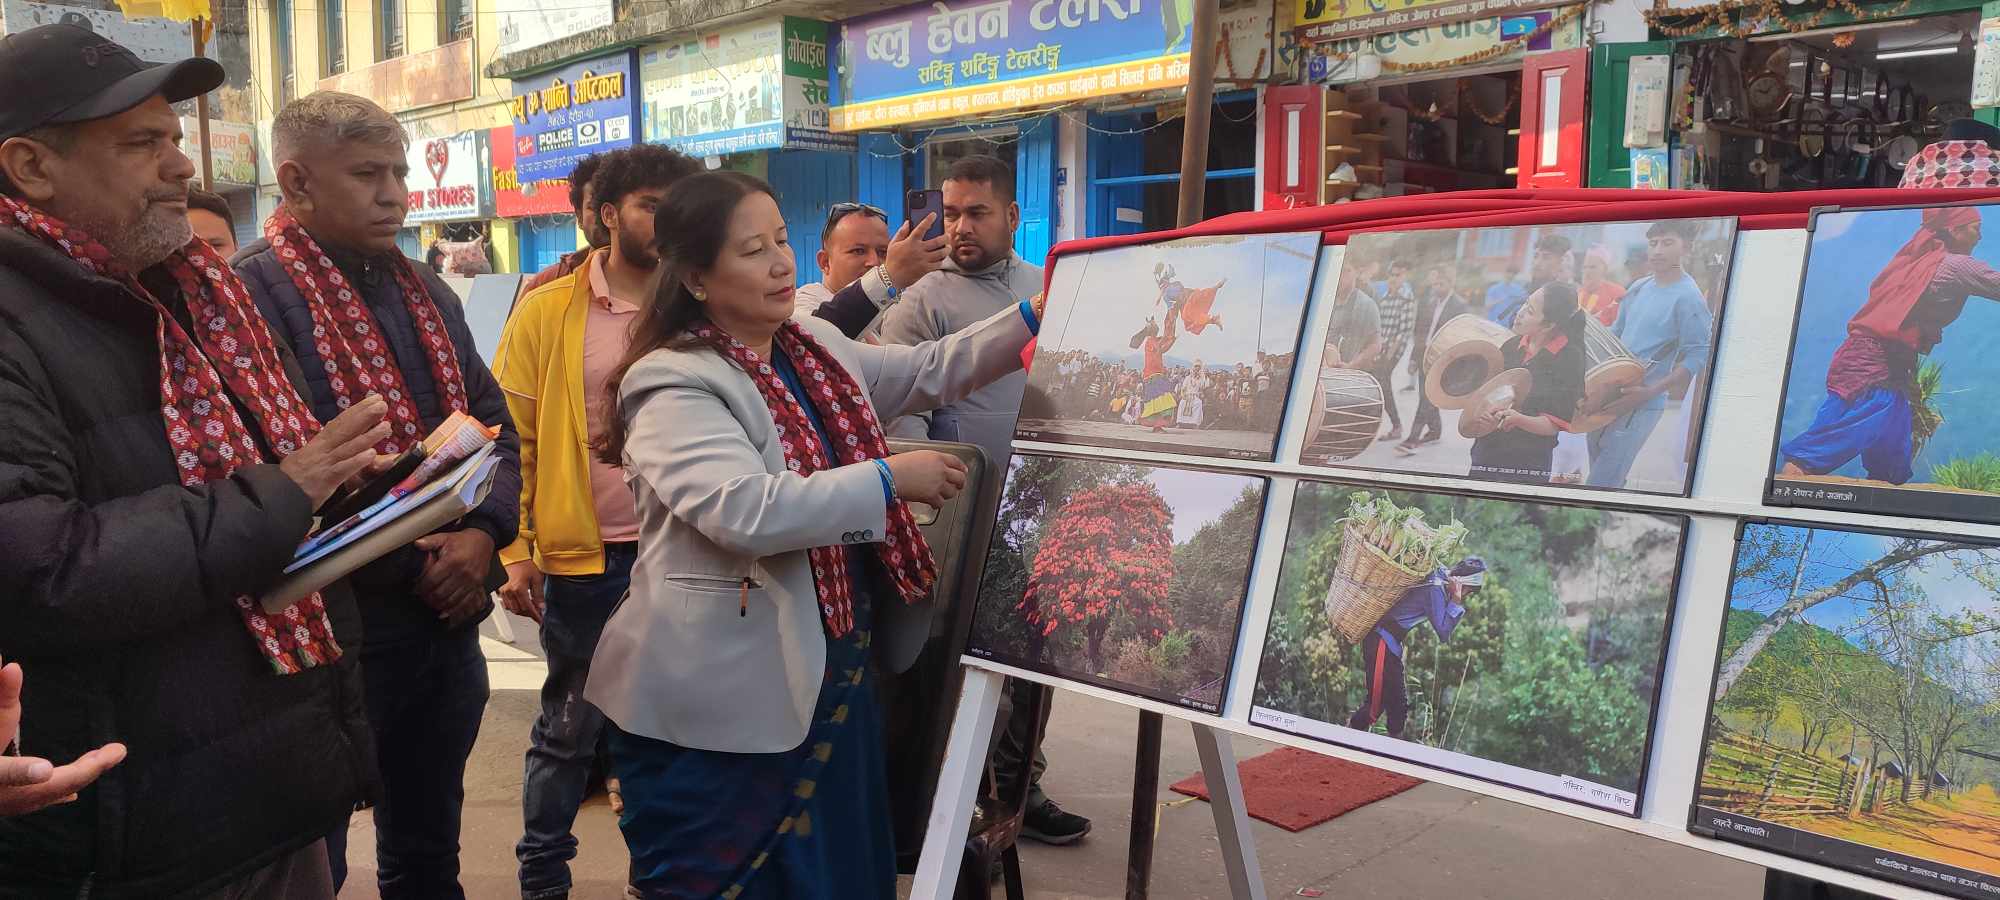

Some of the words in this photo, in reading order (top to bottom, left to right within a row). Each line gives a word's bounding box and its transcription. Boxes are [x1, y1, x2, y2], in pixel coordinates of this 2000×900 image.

[568, 11, 609, 33] POLICE
[866, 21, 913, 69] ब्लु
[927, 2, 1014, 54] हेवन
[539, 128, 574, 143] POLICE
[427, 184, 476, 209] STORES
